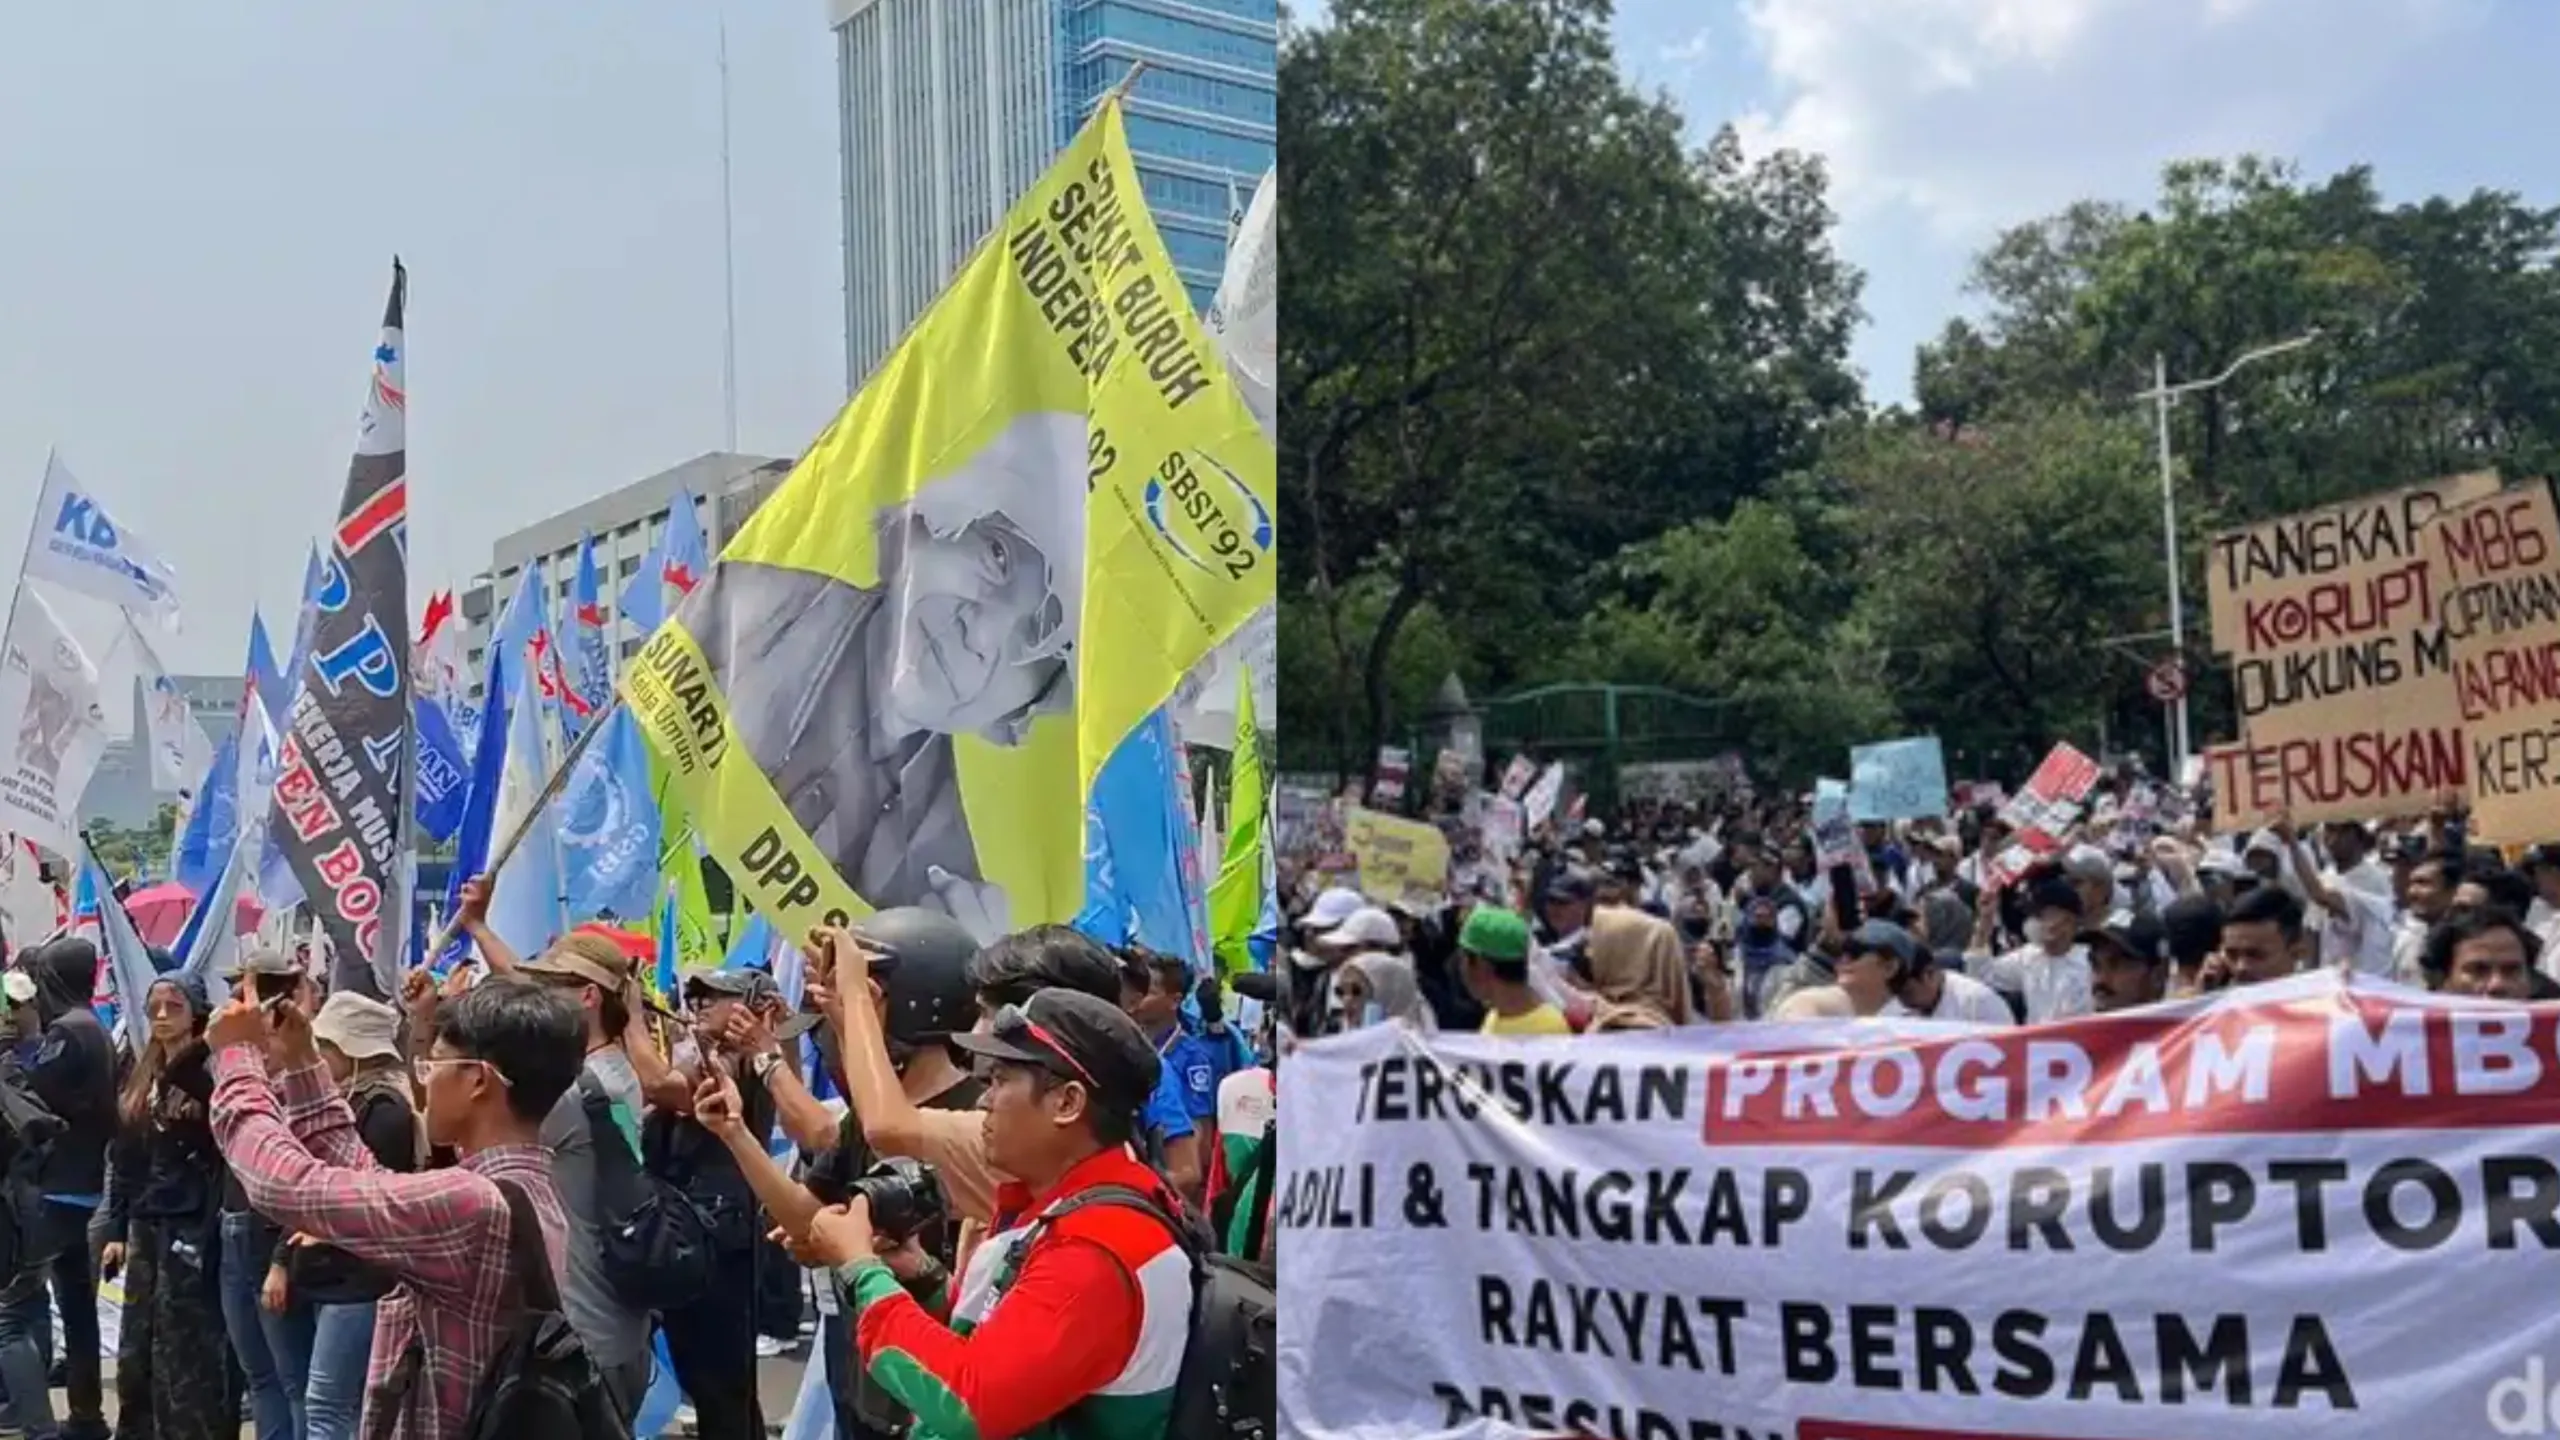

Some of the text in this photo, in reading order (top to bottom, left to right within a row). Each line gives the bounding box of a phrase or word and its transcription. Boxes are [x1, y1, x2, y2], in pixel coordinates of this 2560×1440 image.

[1113, 274, 1212, 410] BURUH
[291, 680, 363, 801] EKERJA
[655, 702, 696, 776] Umum
[2205, 727, 2467, 816] TERUSKAN
[739, 825, 820, 911] DPP
[1355, 1005, 2560, 1124] TERUSKAN PROGRAM MB
[1278, 1156, 2560, 1253] ADILI & TANGKAP KORUPTOR
[1480, 1275, 2358, 1410] RAKYAT BERSAMA
